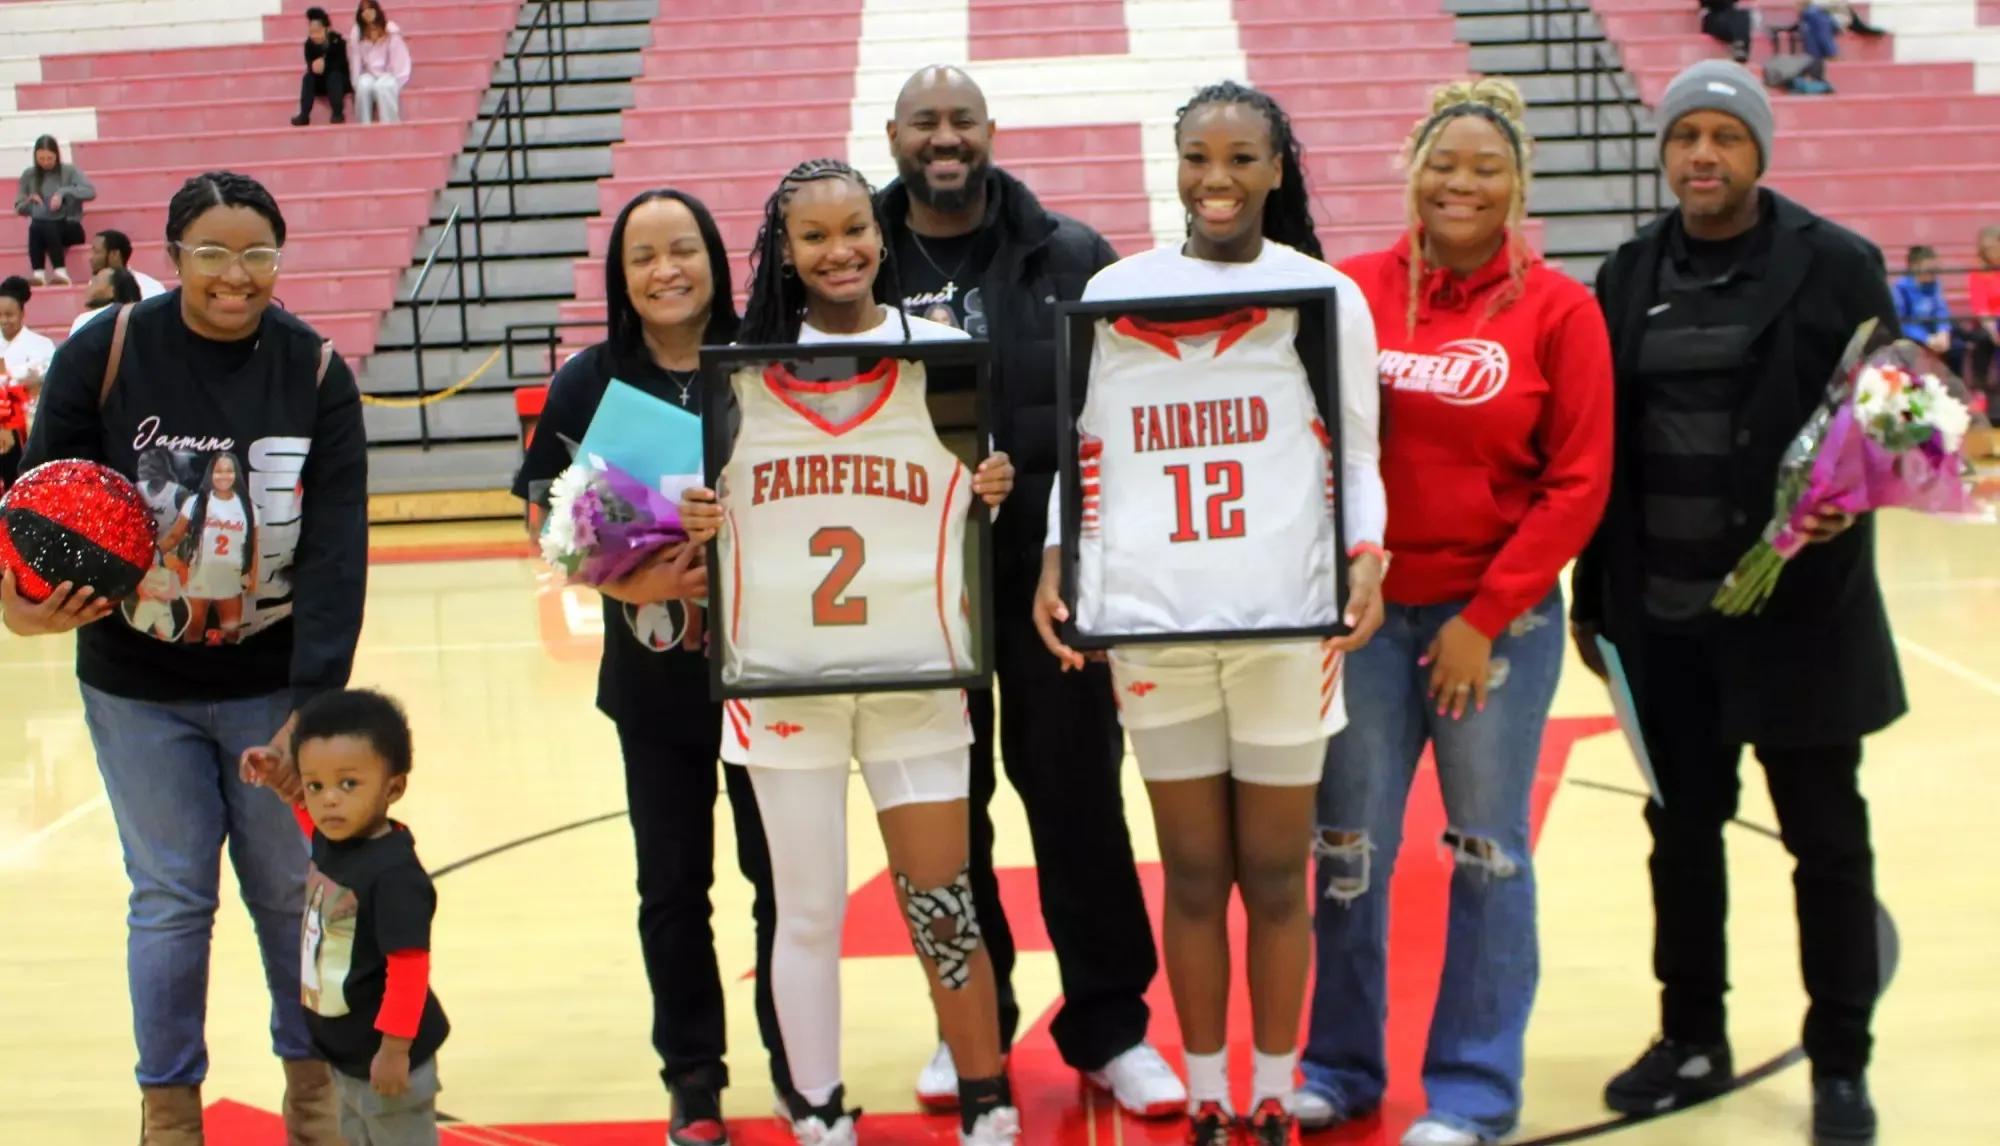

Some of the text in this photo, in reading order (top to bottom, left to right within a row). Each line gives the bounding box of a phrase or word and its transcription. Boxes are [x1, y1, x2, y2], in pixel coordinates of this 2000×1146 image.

[133, 415, 234, 452] Jasmine
[1131, 396, 1269, 452] FAIRFIELD
[752, 454, 929, 507] FAIRFIELD
[1163, 460, 1247, 544] 12
[215, 535, 230, 556] 2
[809, 525, 868, 627] 2
